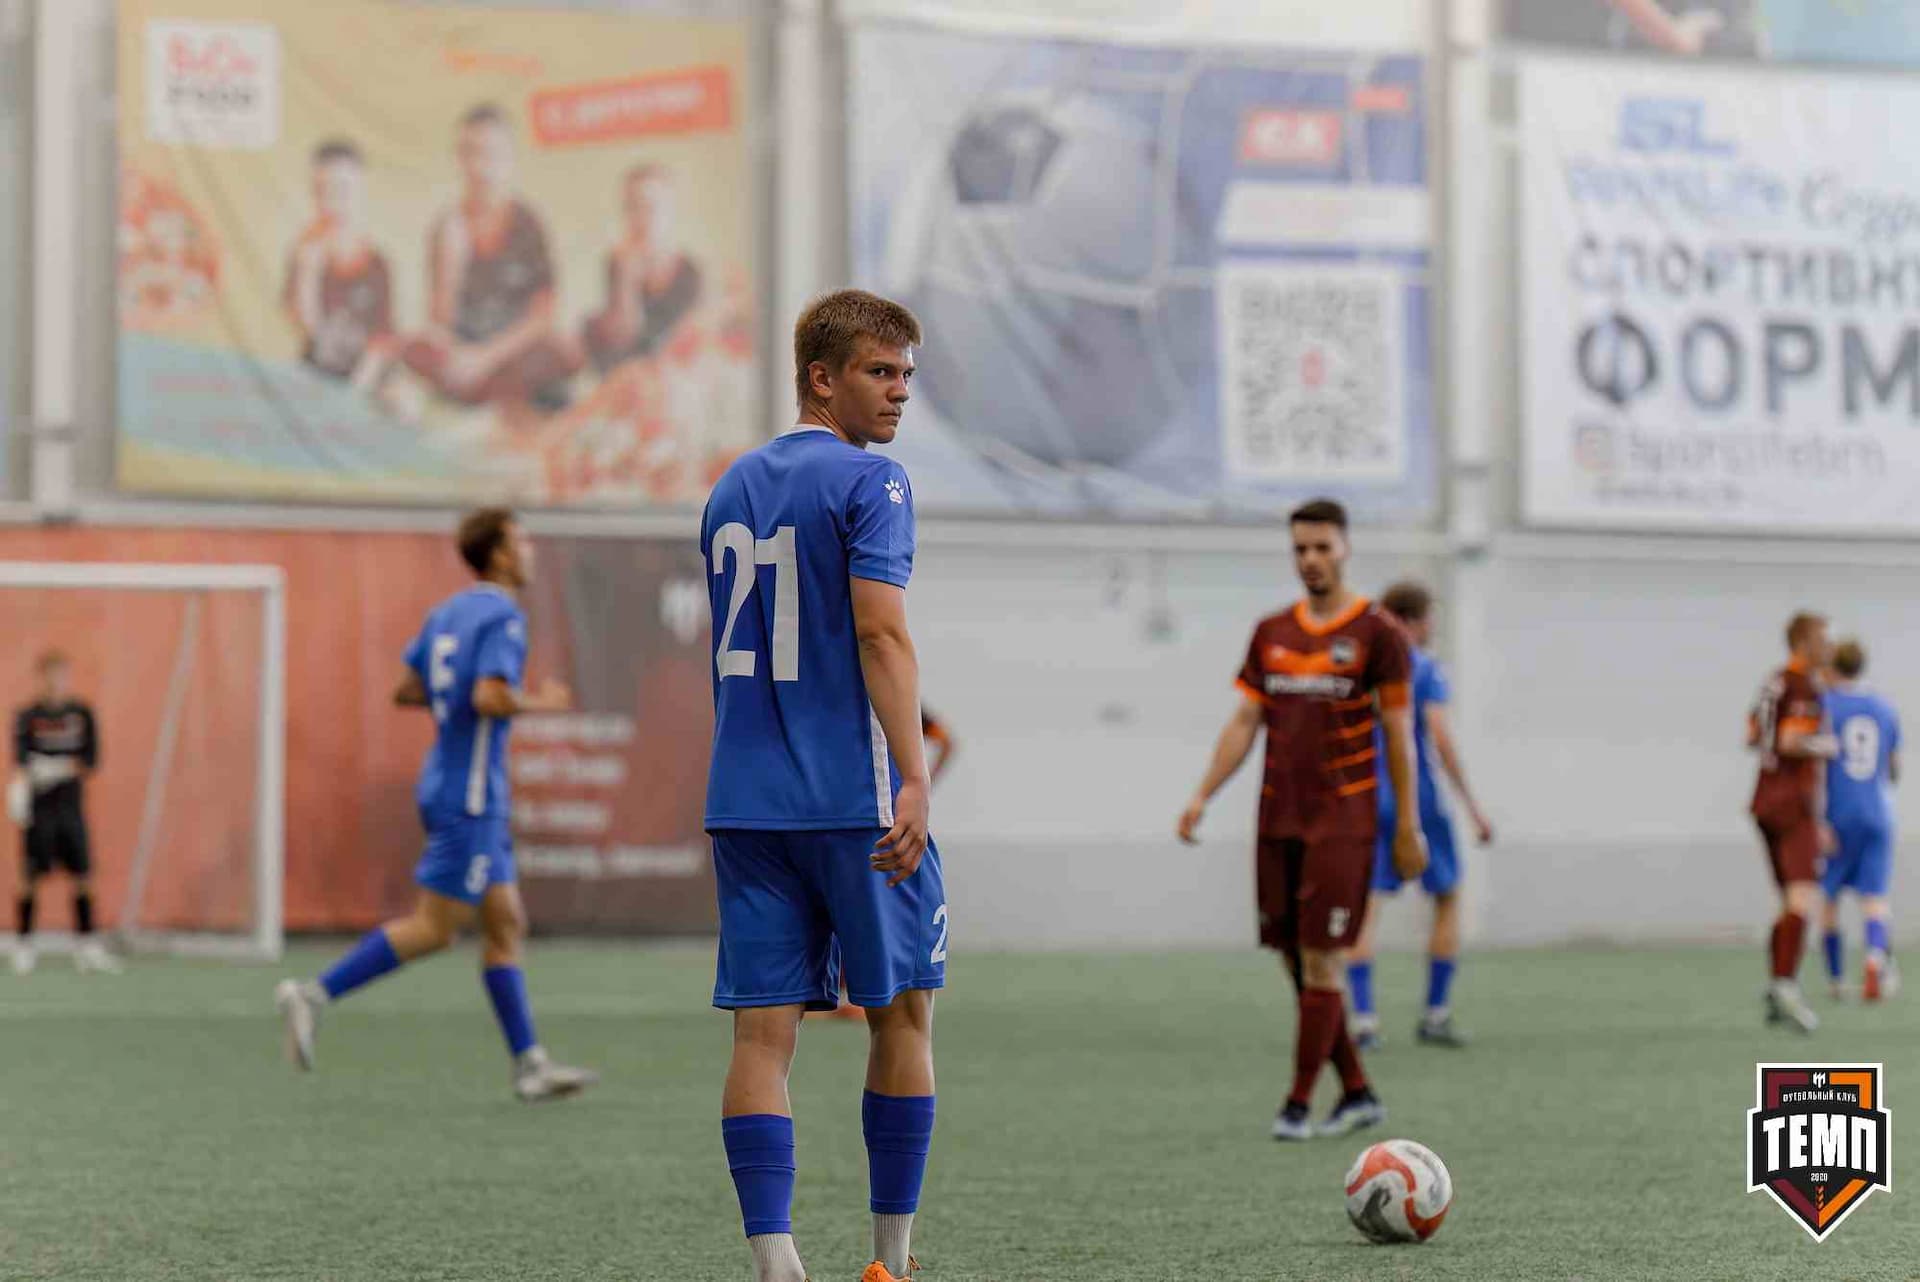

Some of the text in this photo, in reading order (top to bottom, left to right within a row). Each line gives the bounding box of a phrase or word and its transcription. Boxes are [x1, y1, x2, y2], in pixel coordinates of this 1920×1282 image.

[1571, 232, 1919, 303] СПОРТИВН
[1575, 312, 1919, 420] ФОРМ
[711, 522, 800, 682] 21
[1842, 715, 1879, 782] 9
[930, 903, 948, 964] 2
